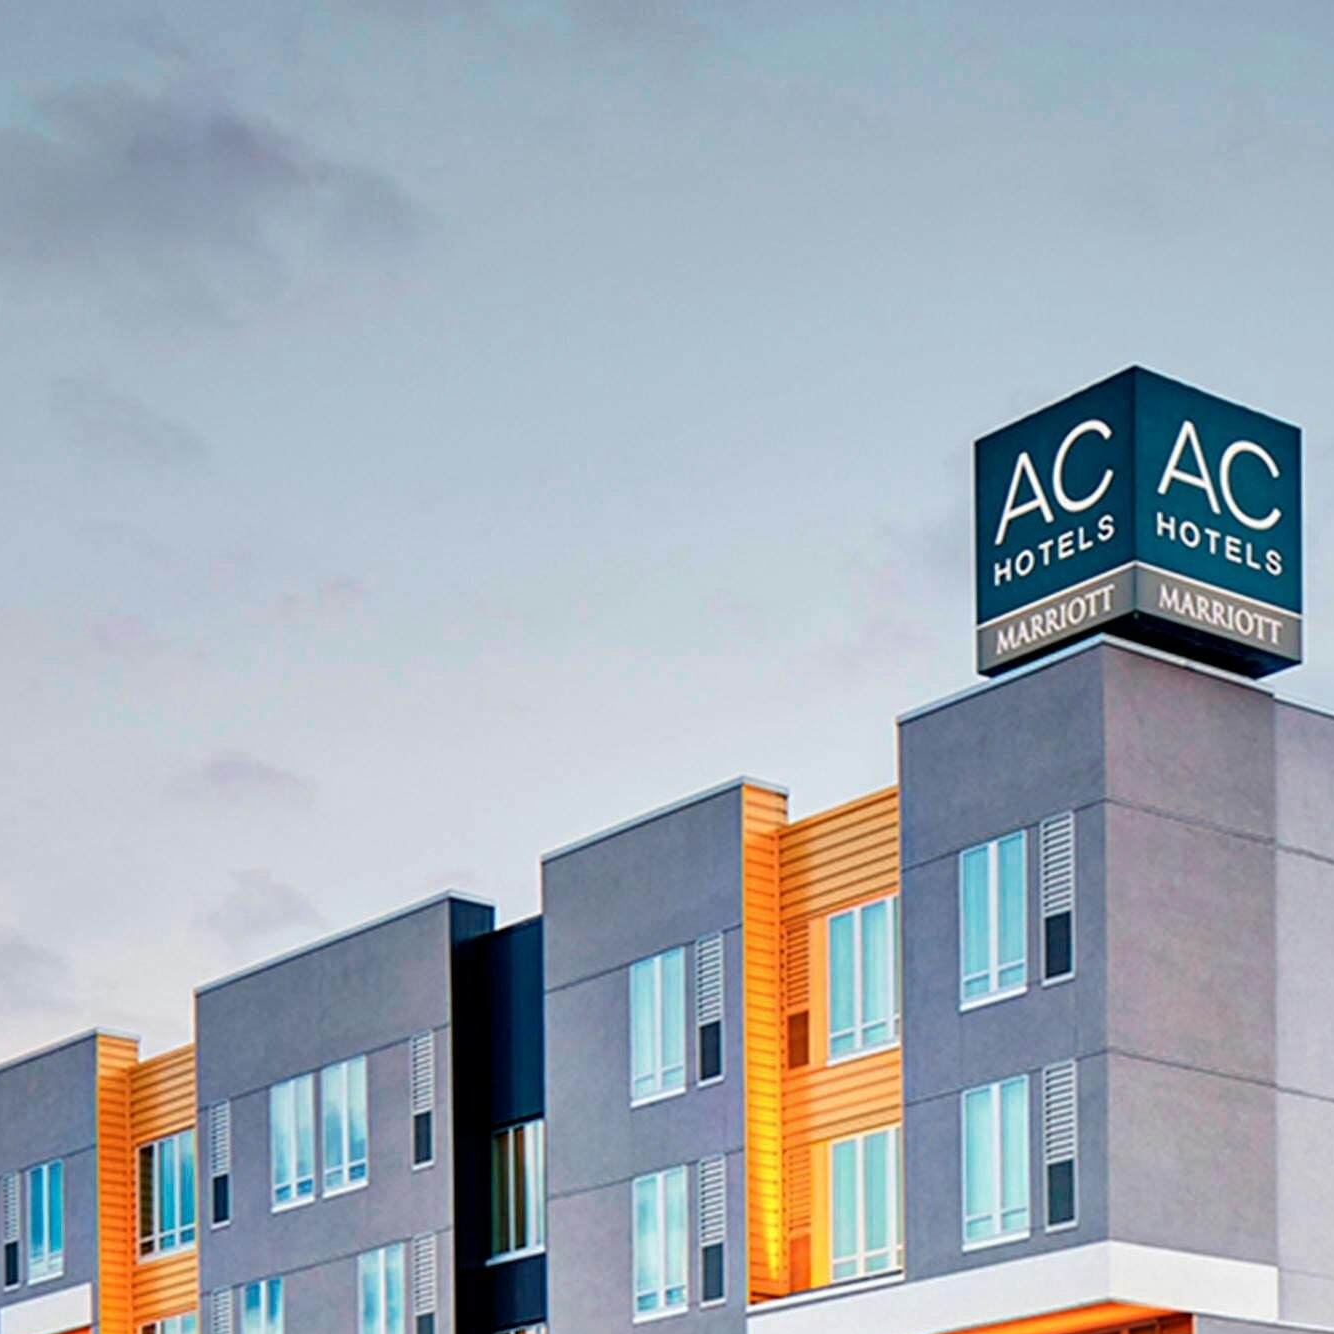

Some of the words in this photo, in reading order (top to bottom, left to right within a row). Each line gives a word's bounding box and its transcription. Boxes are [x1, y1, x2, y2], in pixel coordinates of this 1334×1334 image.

[994, 419, 1113, 545] AC
[1157, 420, 1282, 530] AC
[994, 514, 1115, 586] HOTELS
[1156, 512, 1283, 576] HOTELS
[995, 584, 1115, 655] MARRIOTT
[1158, 584, 1283, 645] MARRIOTT
